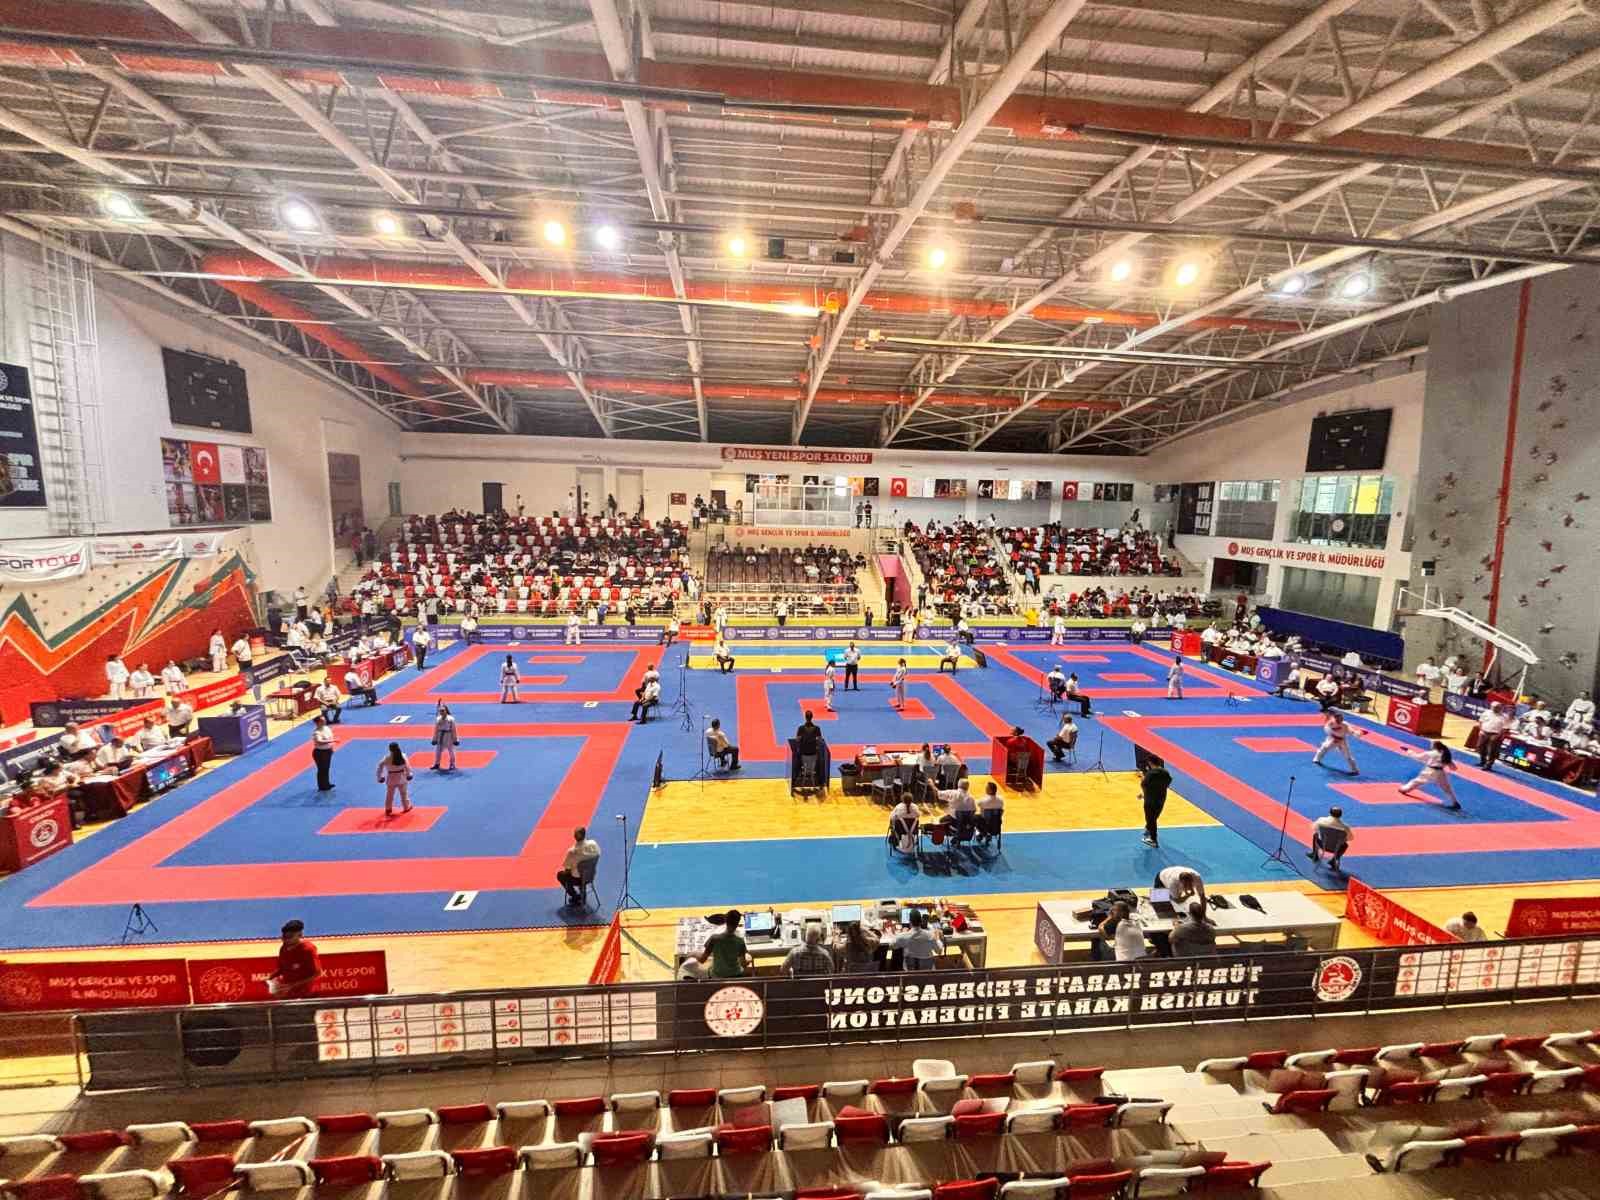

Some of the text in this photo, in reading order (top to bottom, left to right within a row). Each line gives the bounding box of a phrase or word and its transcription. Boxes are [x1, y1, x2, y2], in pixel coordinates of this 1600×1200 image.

[792, 452, 821, 462] SPOR
[823, 453, 868, 463] SALONU
[1256, 546, 1284, 559] GENÇLİK
[1286, 550, 1295, 560] VE
[1297, 551, 1317, 562] SPOR
[1328, 553, 1385, 569] MÜDÜRLÜĞÜ
[329, 968, 344, 977] VE
[346, 967, 376, 977] SPOR
[128, 975, 144, 985] VE
[146, 974, 176, 985] SPOR
